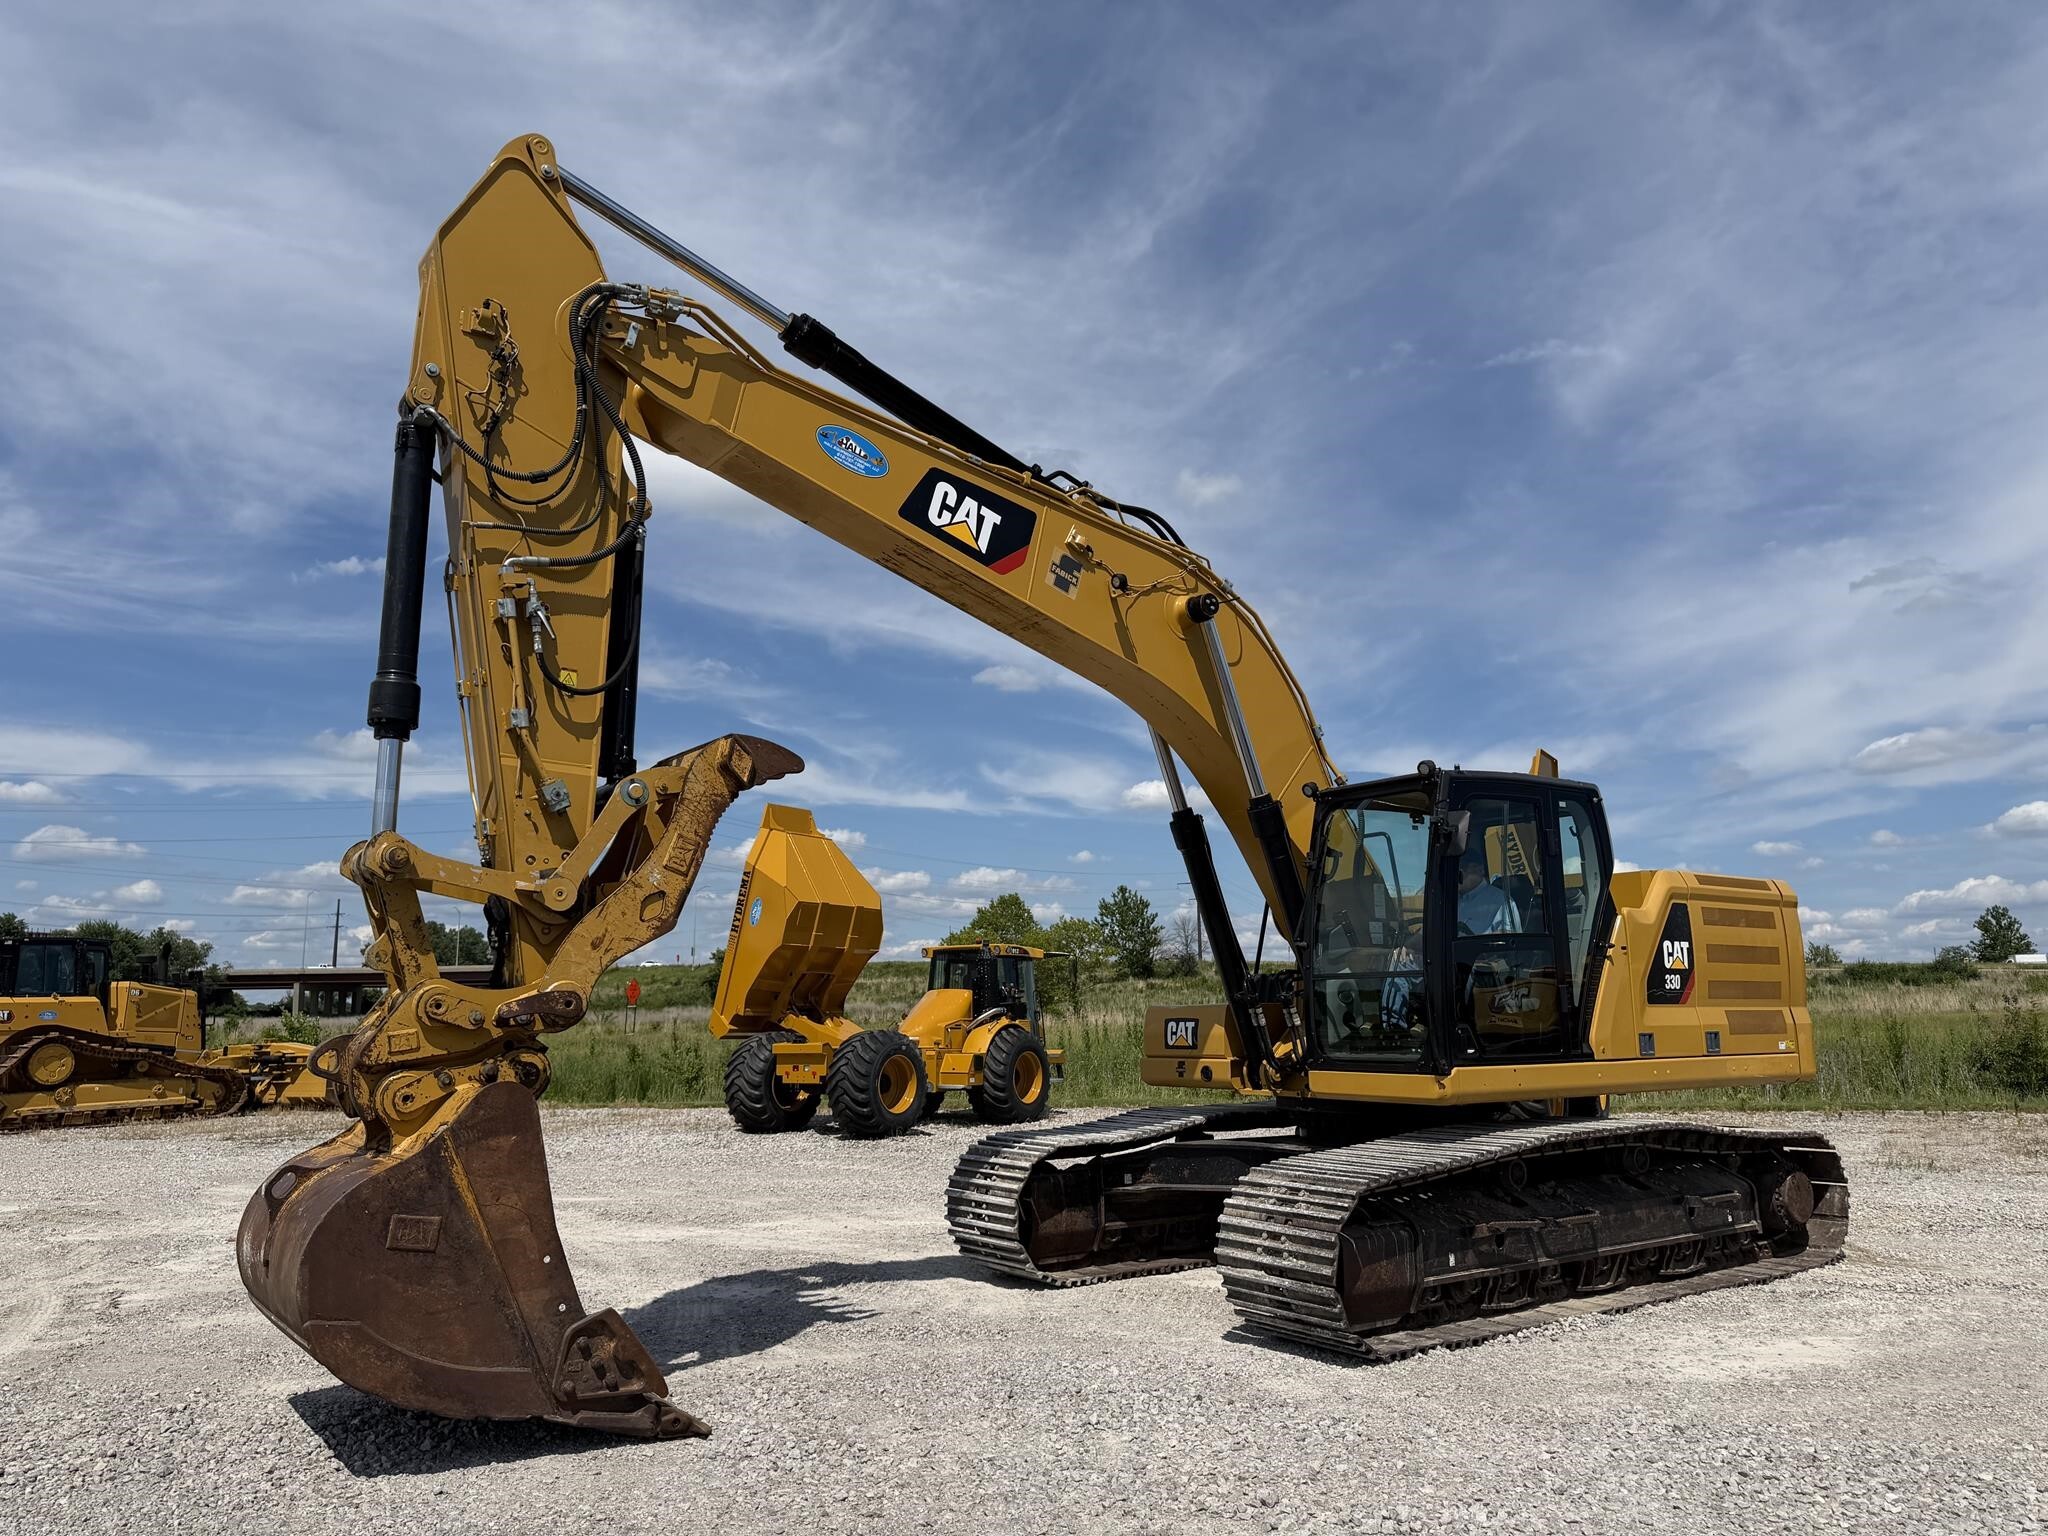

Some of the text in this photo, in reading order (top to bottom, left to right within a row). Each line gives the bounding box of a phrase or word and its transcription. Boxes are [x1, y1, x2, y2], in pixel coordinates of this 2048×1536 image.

[928, 481, 1002, 554] CAT
[1051, 563, 1078, 586] FABICK
[731, 871, 751, 934] HYDREMA
[1662, 940, 1690, 969] CAT
[1665, 974, 1681, 990] 330
[0, 1010, 9, 1021] AT
[1167, 1021, 1195, 1047] CAT
